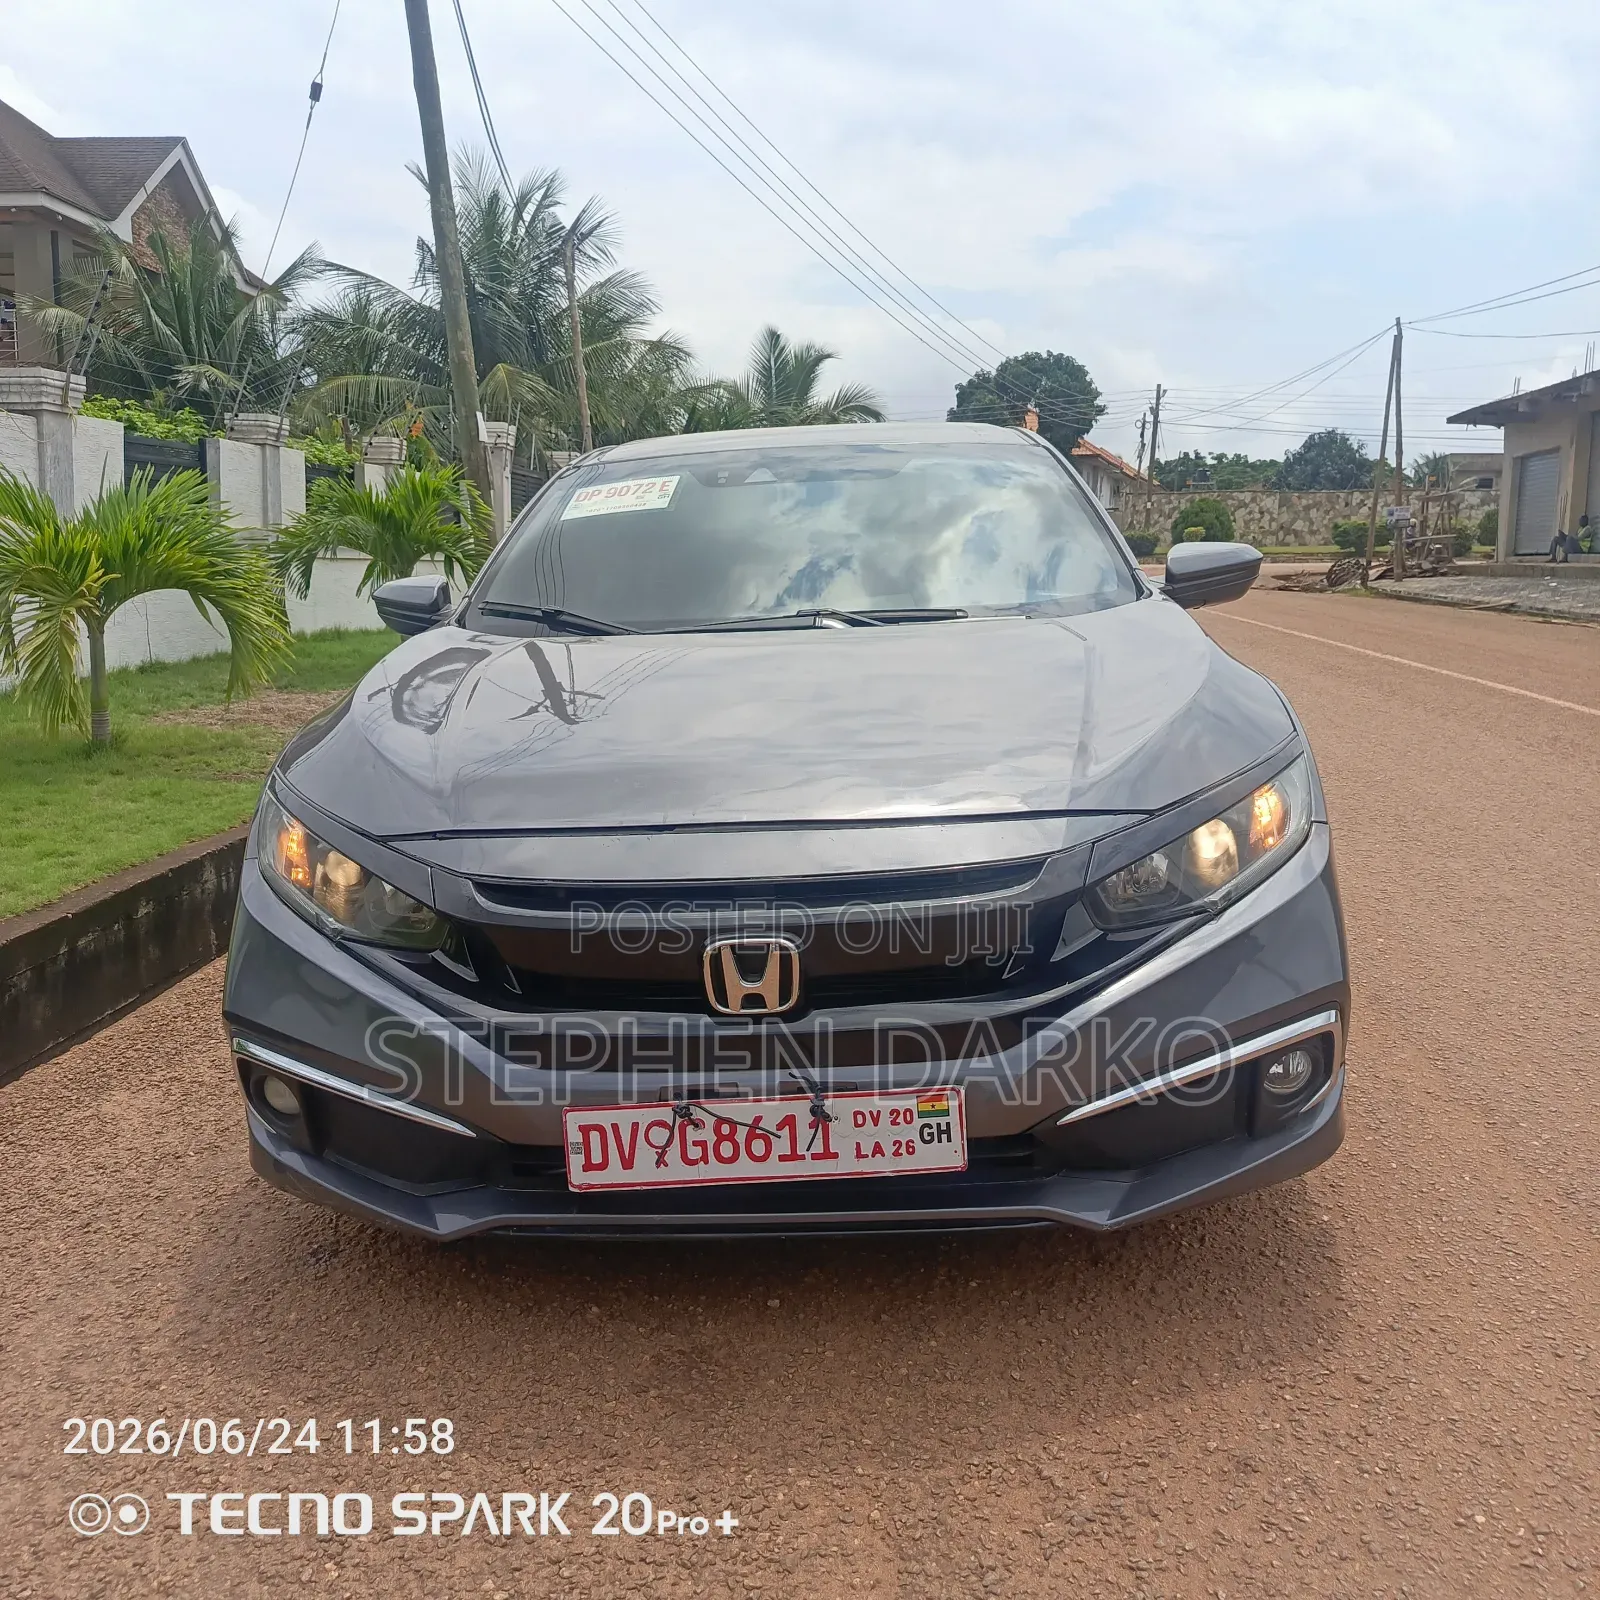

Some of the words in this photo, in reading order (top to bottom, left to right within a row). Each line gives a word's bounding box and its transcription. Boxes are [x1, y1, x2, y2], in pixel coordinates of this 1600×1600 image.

[604, 482, 656, 498] 9072
[659, 480, 673, 492] E
[853, 1109, 881, 1129] DV
[888, 1107, 914, 1126] 20
[919, 1121, 952, 1145] GH
[854, 1140, 886, 1160] LA
[892, 1138, 916, 1158] 26
